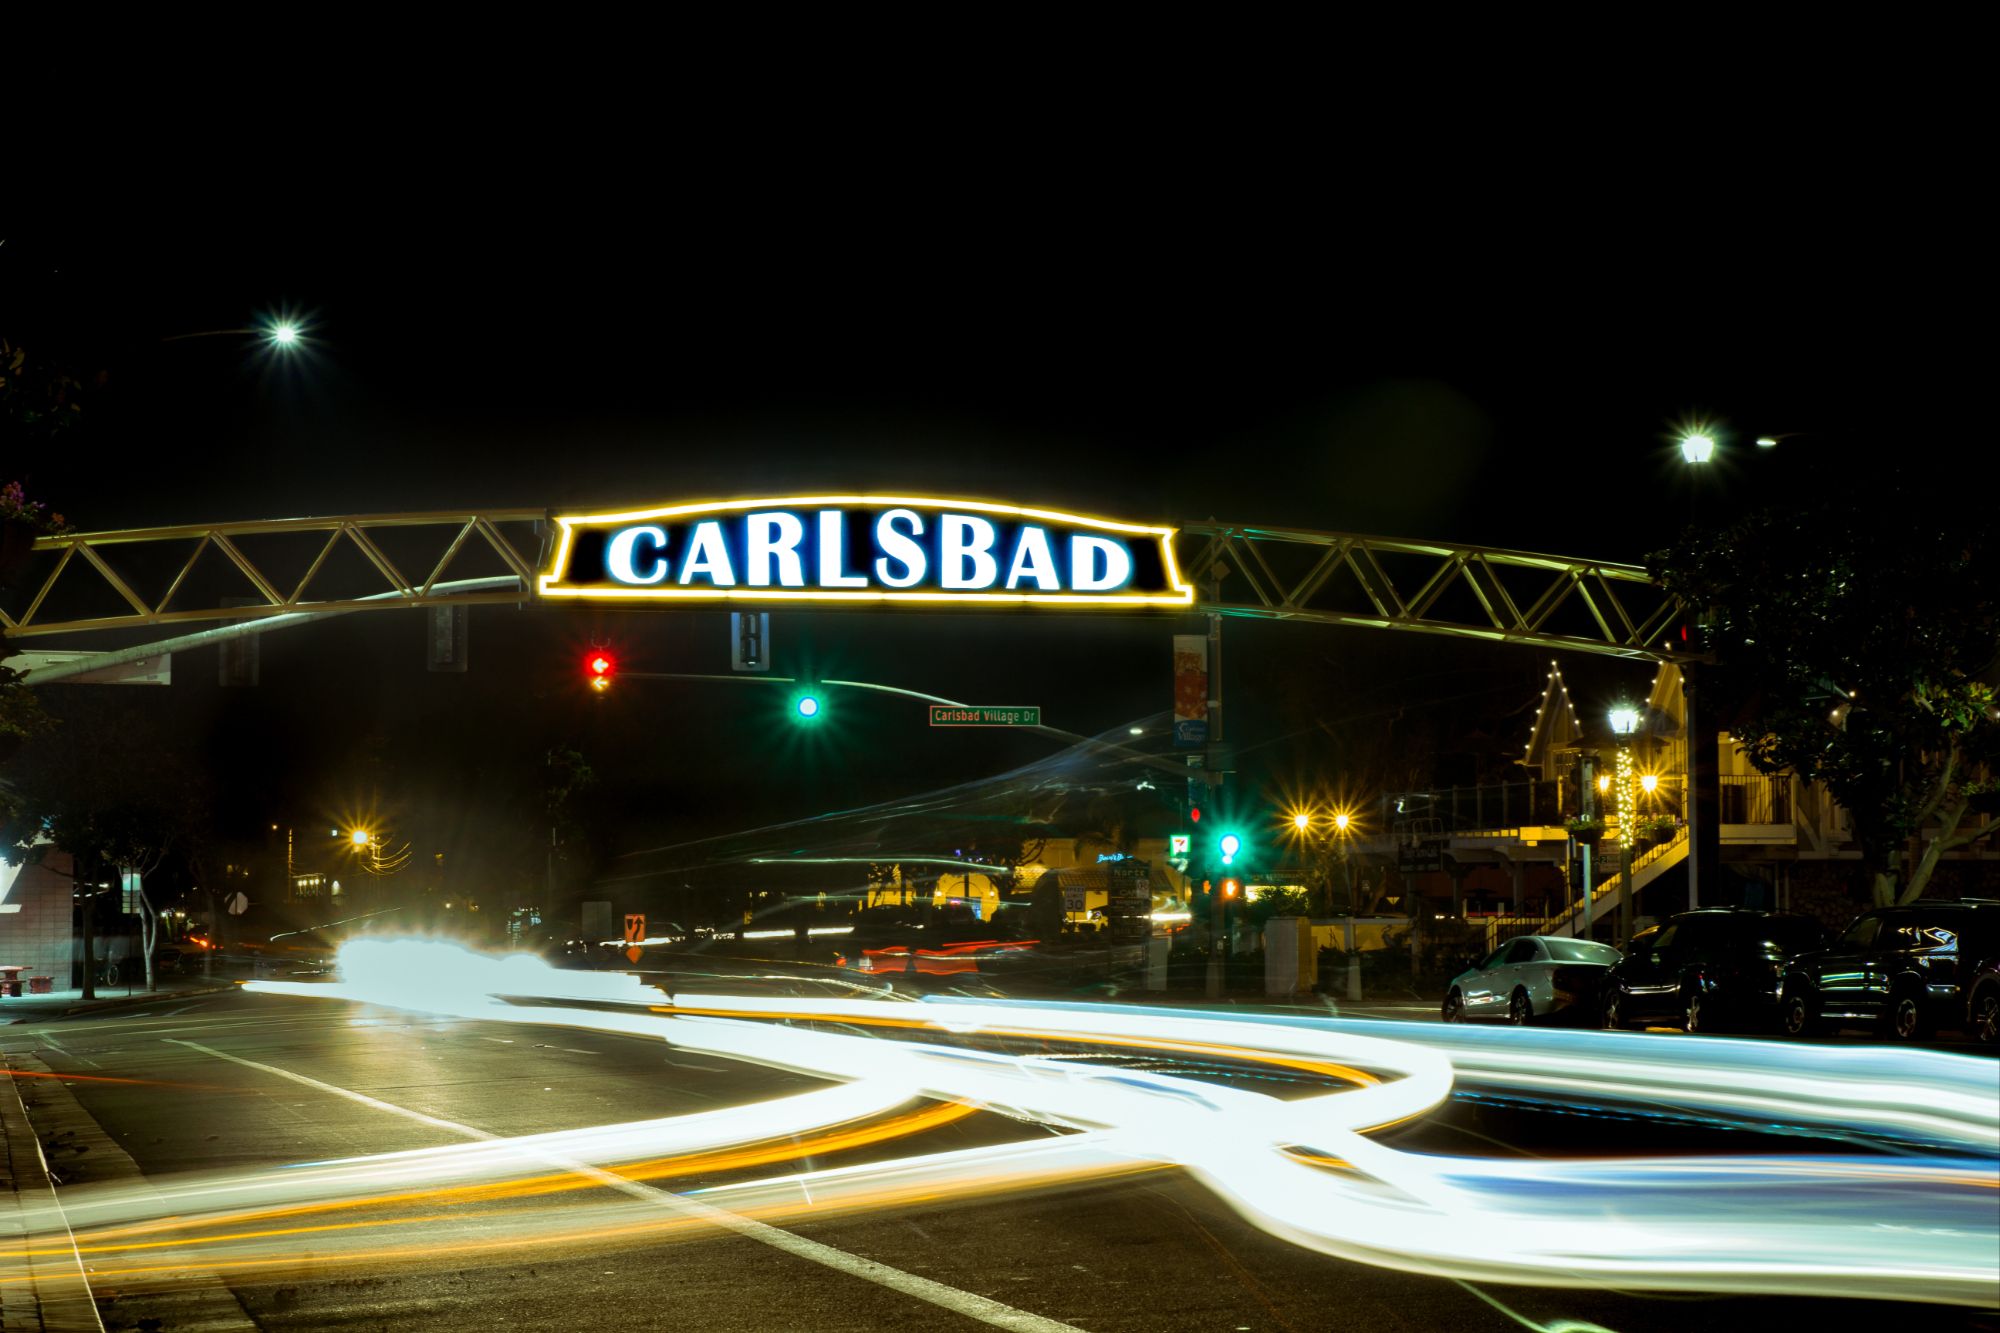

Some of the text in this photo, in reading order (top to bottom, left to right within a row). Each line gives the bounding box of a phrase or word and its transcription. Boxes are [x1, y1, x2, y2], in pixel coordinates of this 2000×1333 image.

[606, 509, 1131, 591] CARLSBAD
[935, 710, 1035, 724] Carlsbad Village Dr
[1066, 899, 1084, 910] 30
